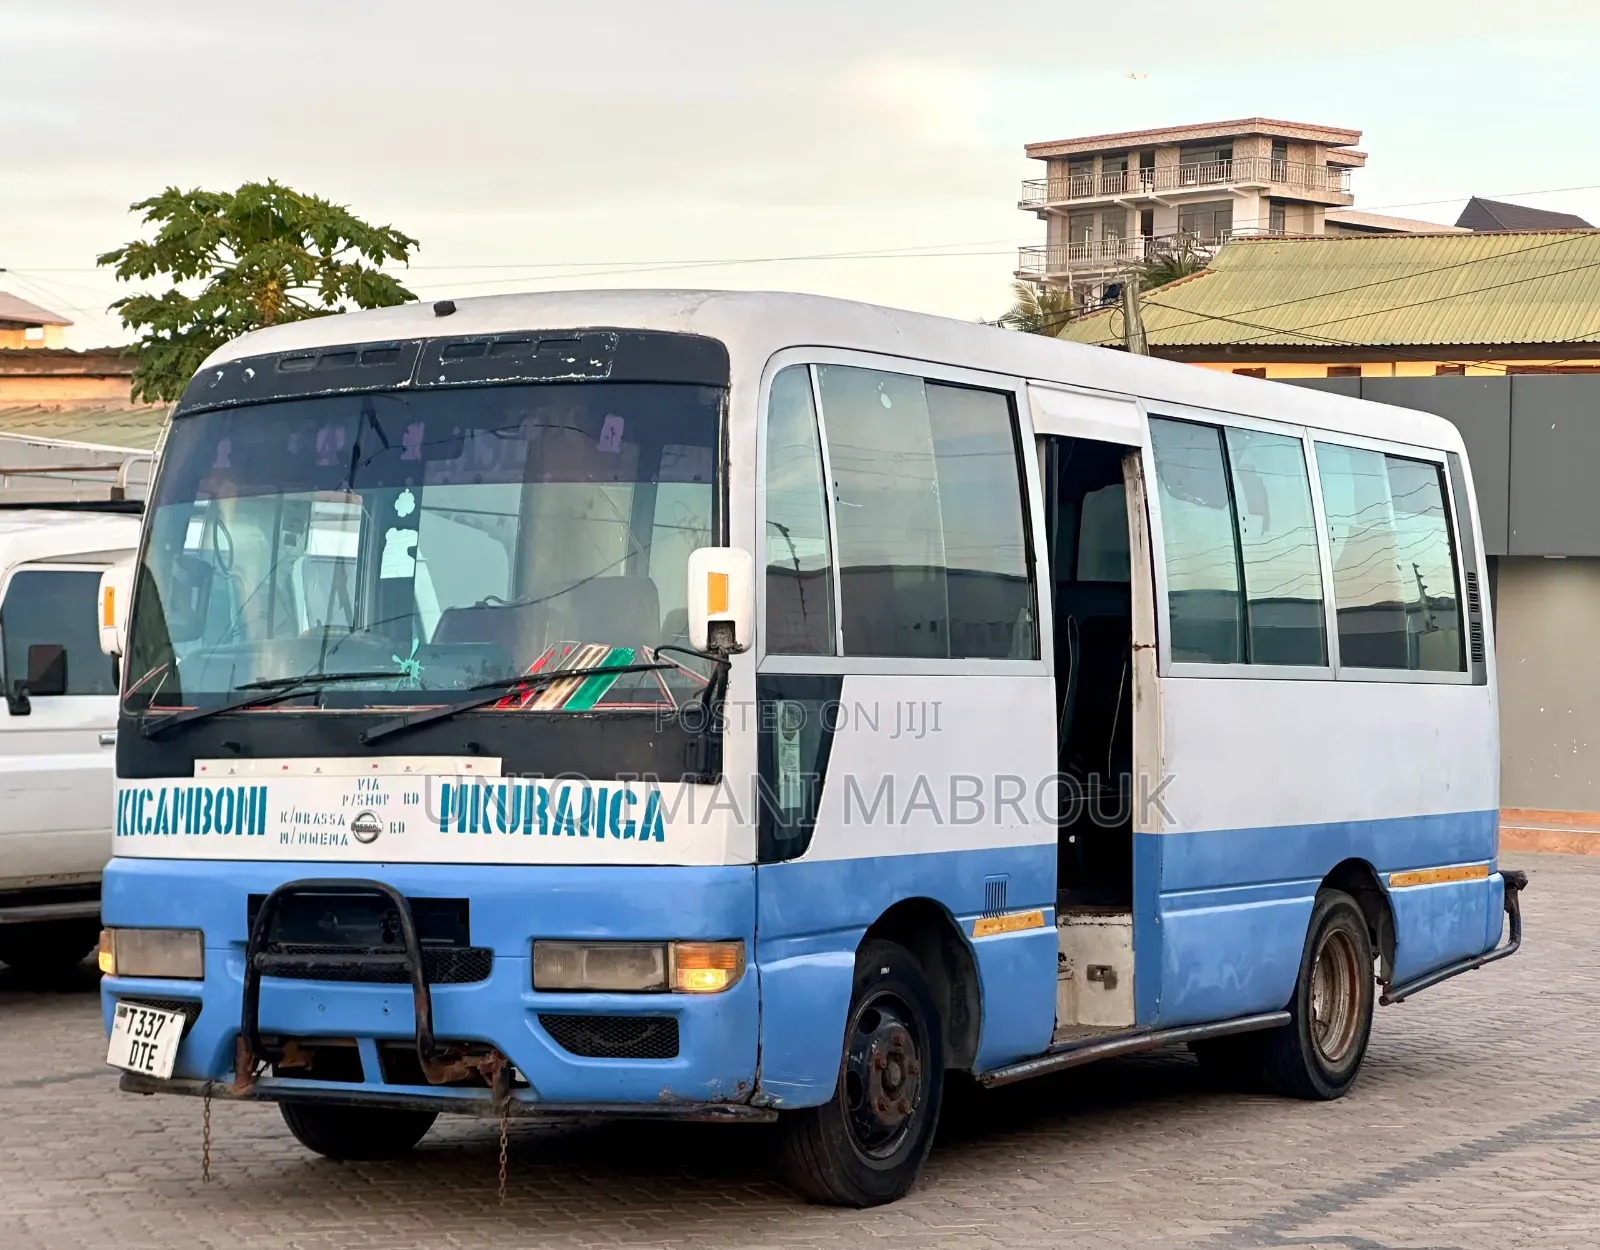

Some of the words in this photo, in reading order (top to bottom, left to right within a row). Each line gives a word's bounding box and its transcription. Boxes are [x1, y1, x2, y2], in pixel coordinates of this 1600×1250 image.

[357, 778, 379, 790] VIA
[439, 783, 665, 842] MKURANGA
[127, 1008, 166, 1040] T337
[128, 1039, 158, 1071] DTE
